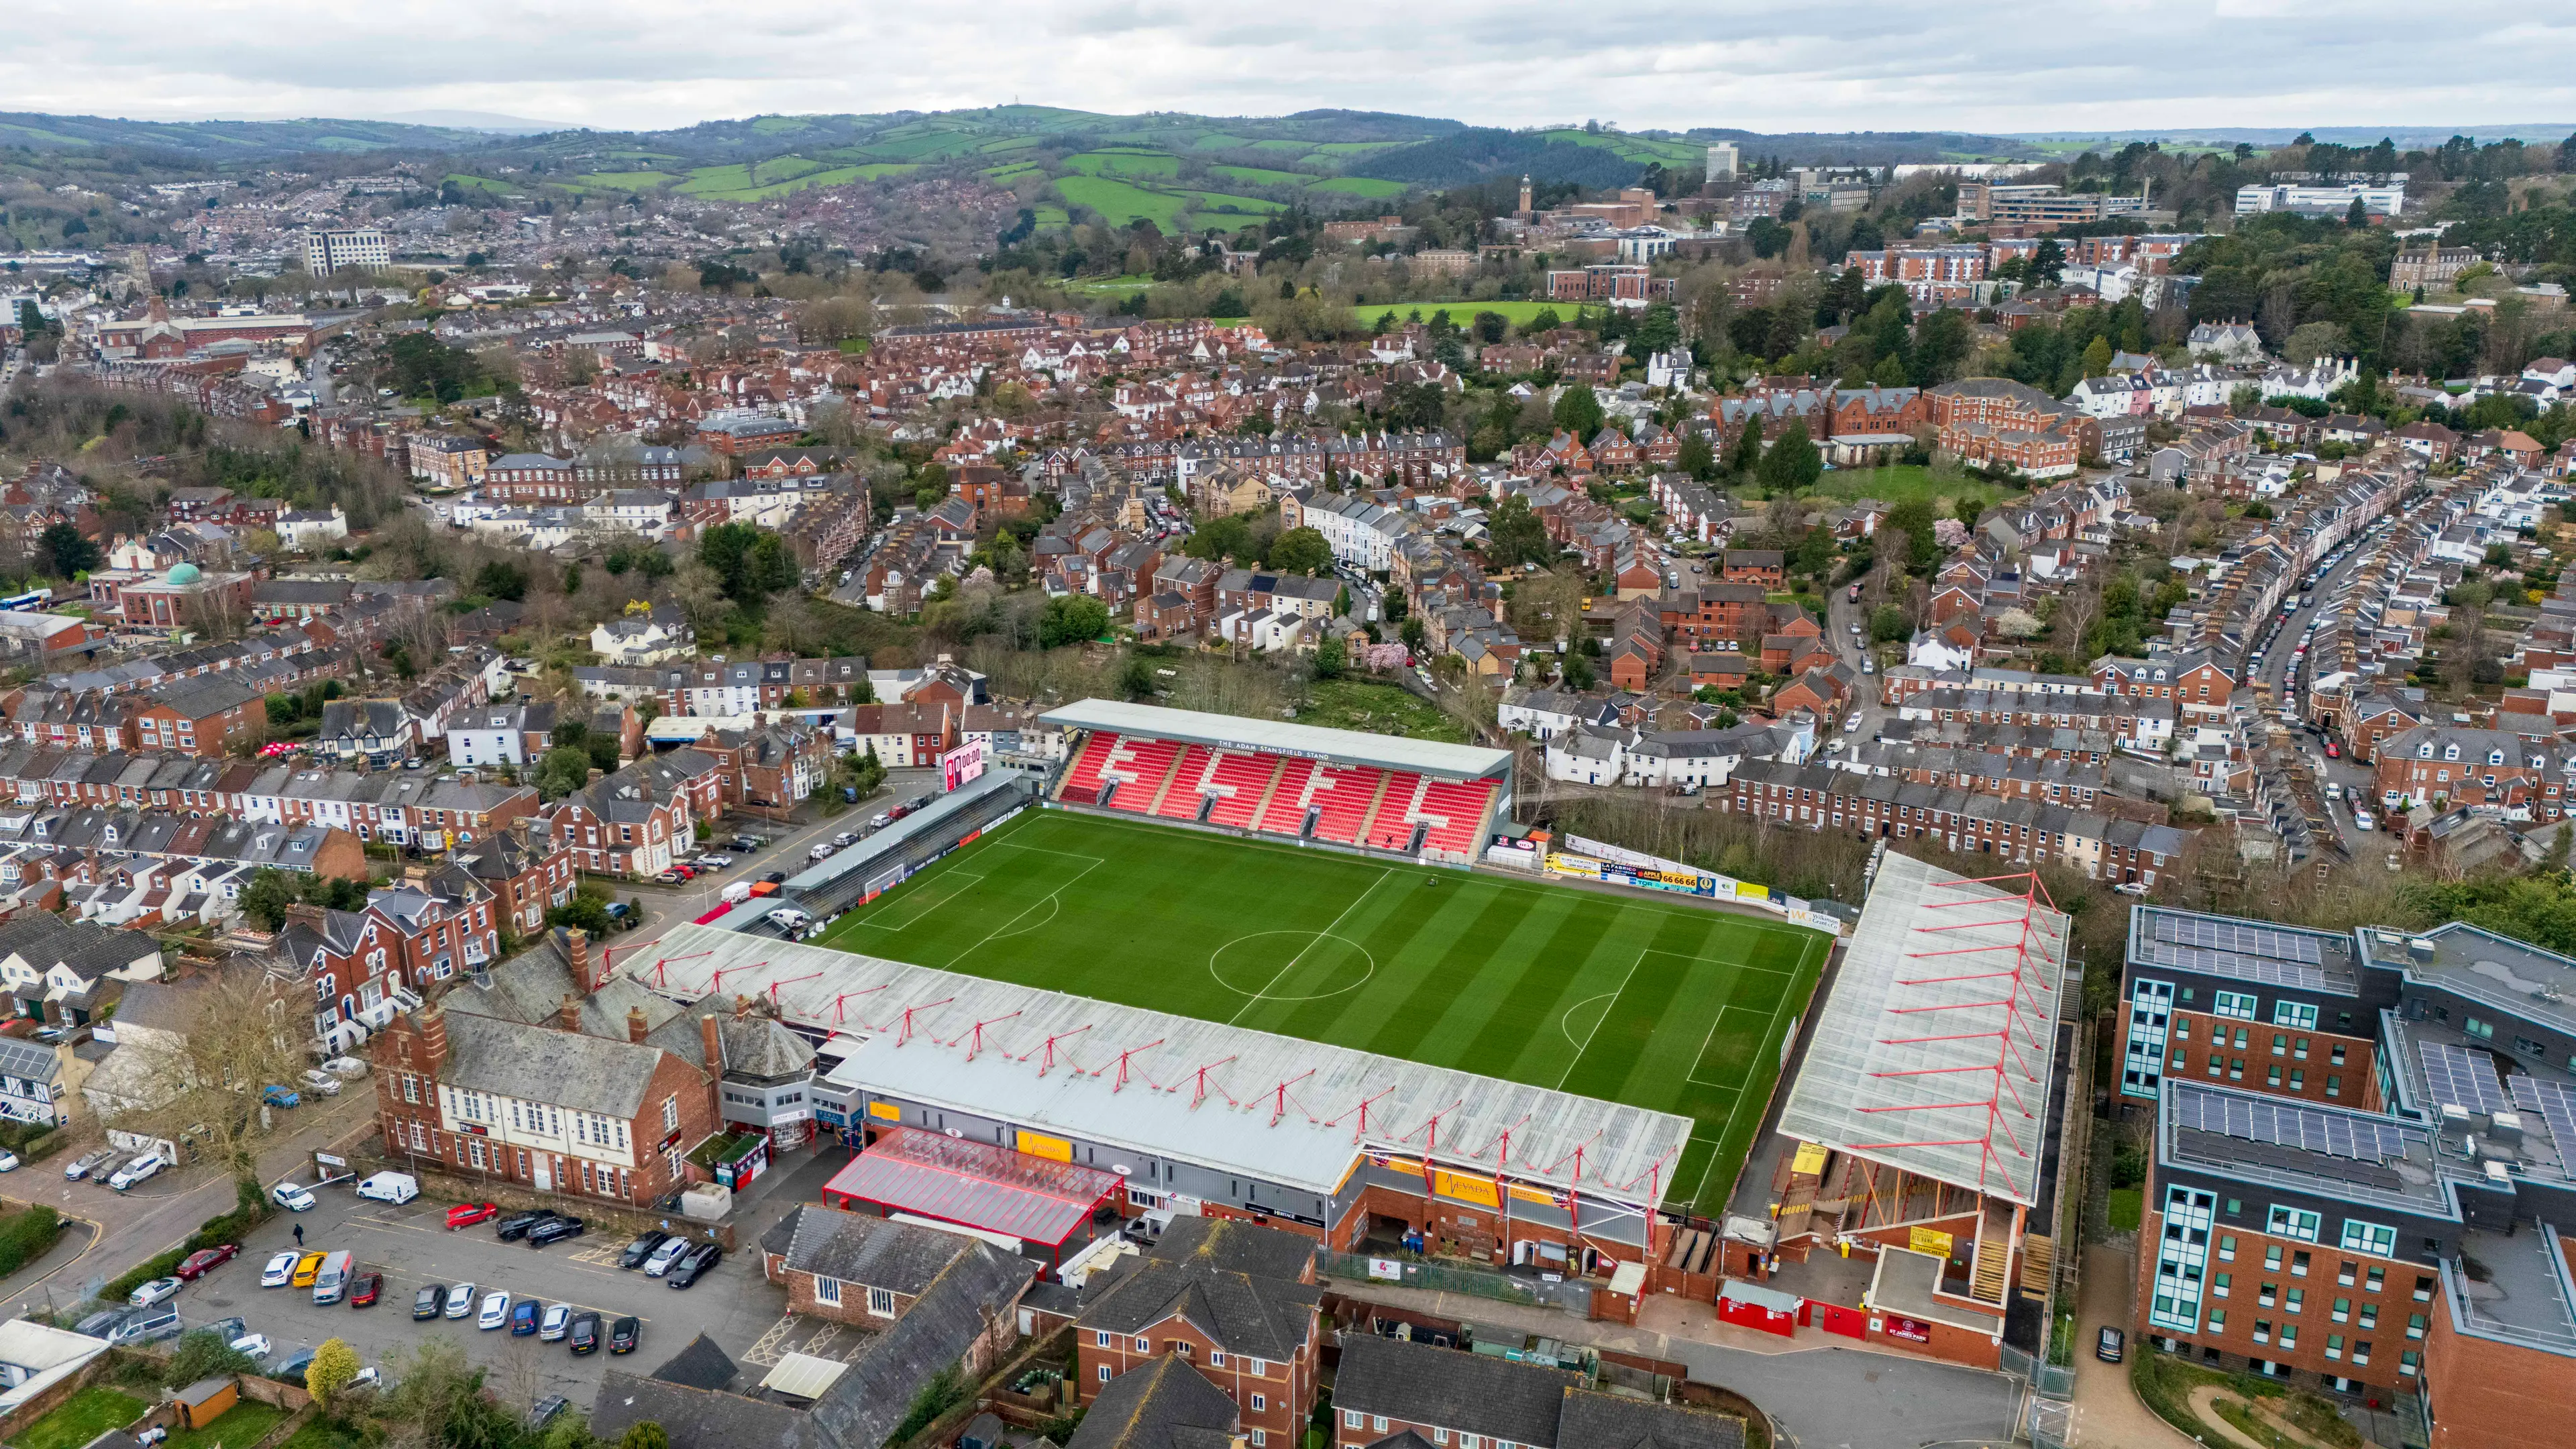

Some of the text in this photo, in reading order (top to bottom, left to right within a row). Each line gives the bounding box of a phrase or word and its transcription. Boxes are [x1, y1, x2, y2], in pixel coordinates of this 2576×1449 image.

[1236, 743, 1256, 751] ADAM
[1260, 745, 1302, 757] STANSFIELD
[1306, 752, 1329, 760] STAND
[962, 748, 980, 768] 00:00
[1674, 877, 1684, 885] 66
[1685, 878, 1695, 886] 66
[1768, 895, 1781, 904] Law
[1813, 913, 1838, 924] Wilkinson
[461, 1124, 471, 1132] the
[659, 1140, 669, 1151] the
[1446, 1173, 1491, 1195] NEVADA
[1274, 1210, 1295, 1220] HERITAGE
[1915, 1246, 1945, 1256] THATCHERS
